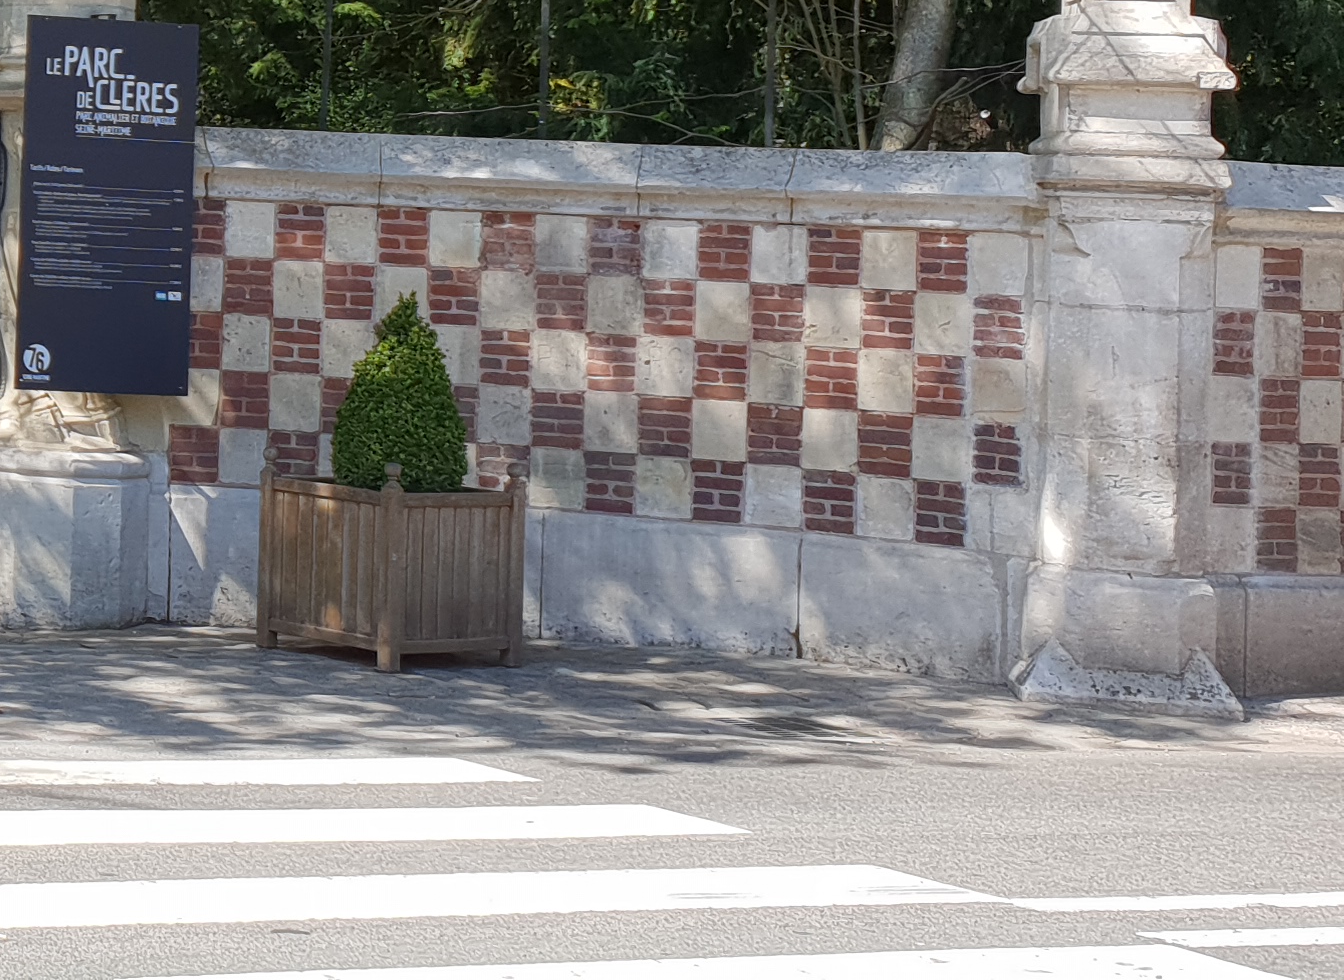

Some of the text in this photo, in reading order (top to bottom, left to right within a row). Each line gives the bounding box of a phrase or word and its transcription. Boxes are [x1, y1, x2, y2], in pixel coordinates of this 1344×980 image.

[45, 45, 125, 88] LE PARC
[76, 91, 93, 109] DE
[26, 346, 46, 373] 76
